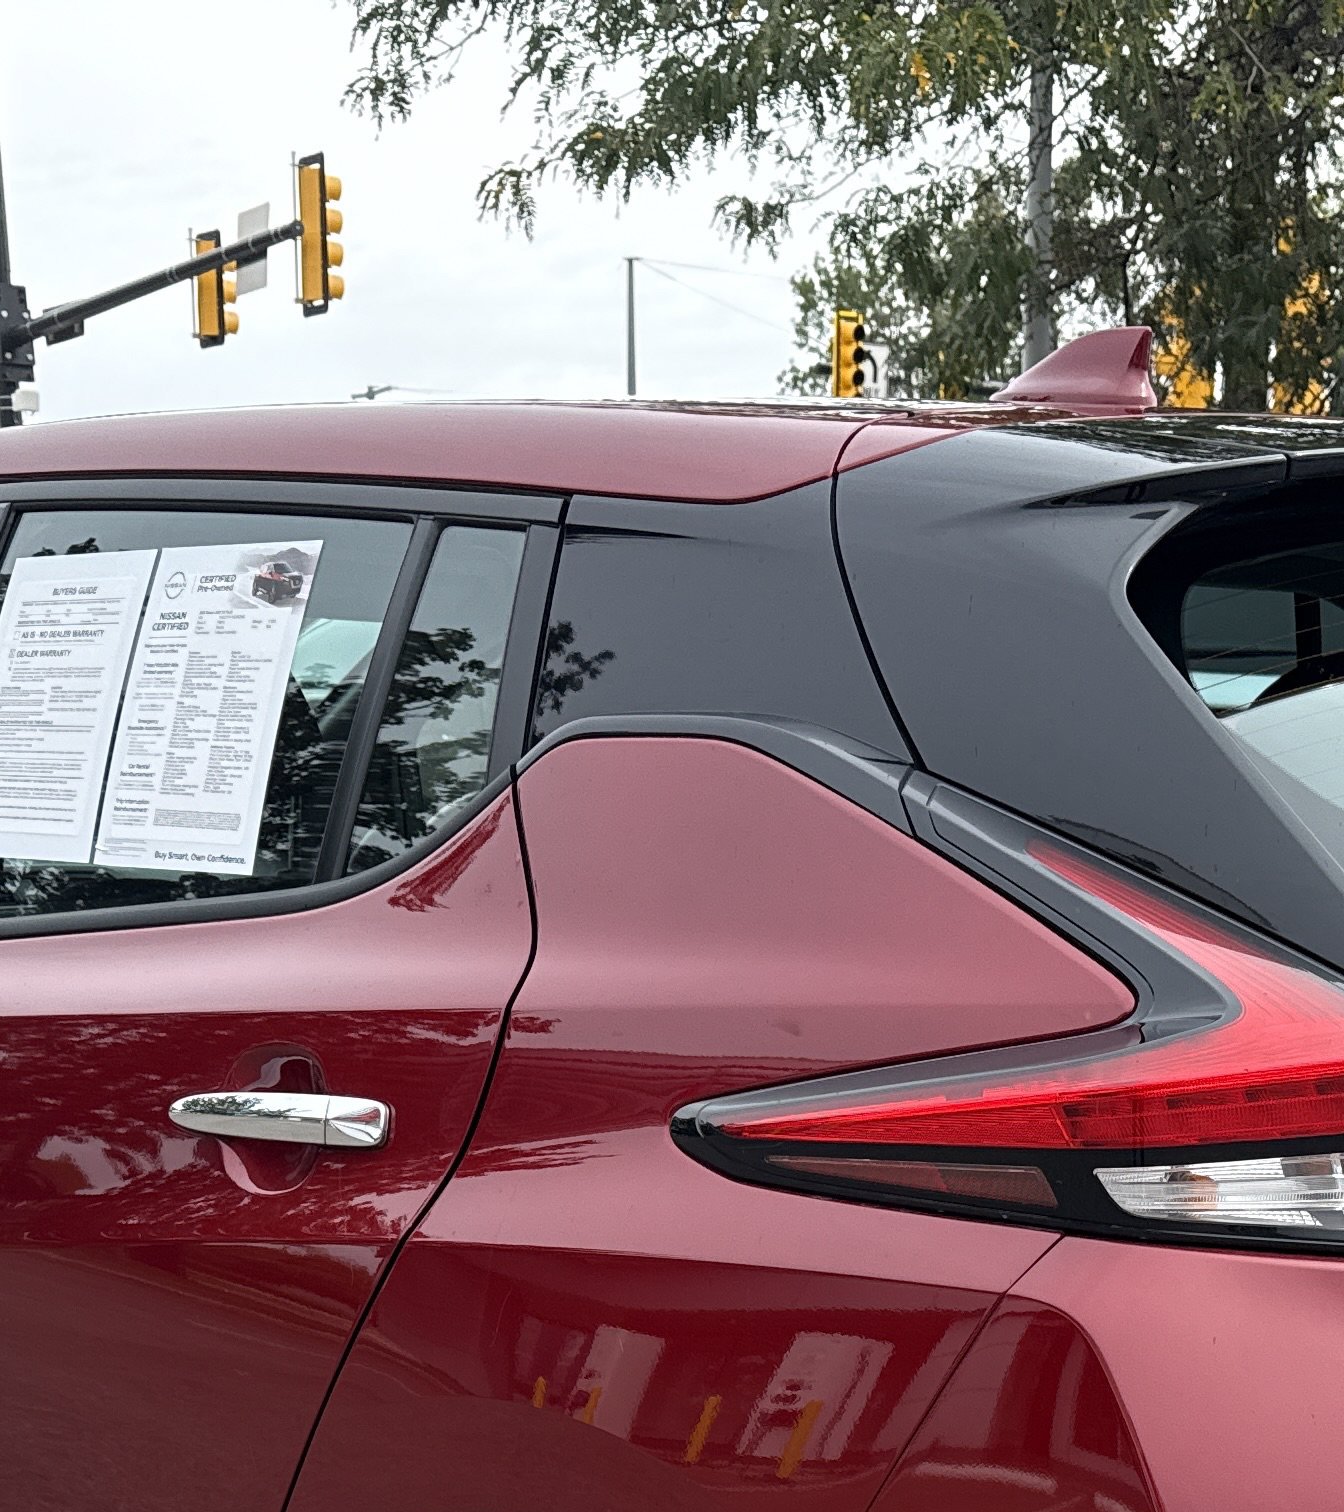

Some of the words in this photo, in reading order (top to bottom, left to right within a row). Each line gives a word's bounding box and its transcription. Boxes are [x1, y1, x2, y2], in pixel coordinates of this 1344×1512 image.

[159, 611, 188, 621] NISSAN
[152, 622, 189, 631] CERTIFIED
[49, 630, 71, 638] DEALER
[72, 629, 105, 638] WARRANTY
[16, 650, 39, 658] DEALER
[39, 649, 71, 658] WARRANTY
[154, 850, 167, 861] Buy
[190, 853, 206, 861] Own
